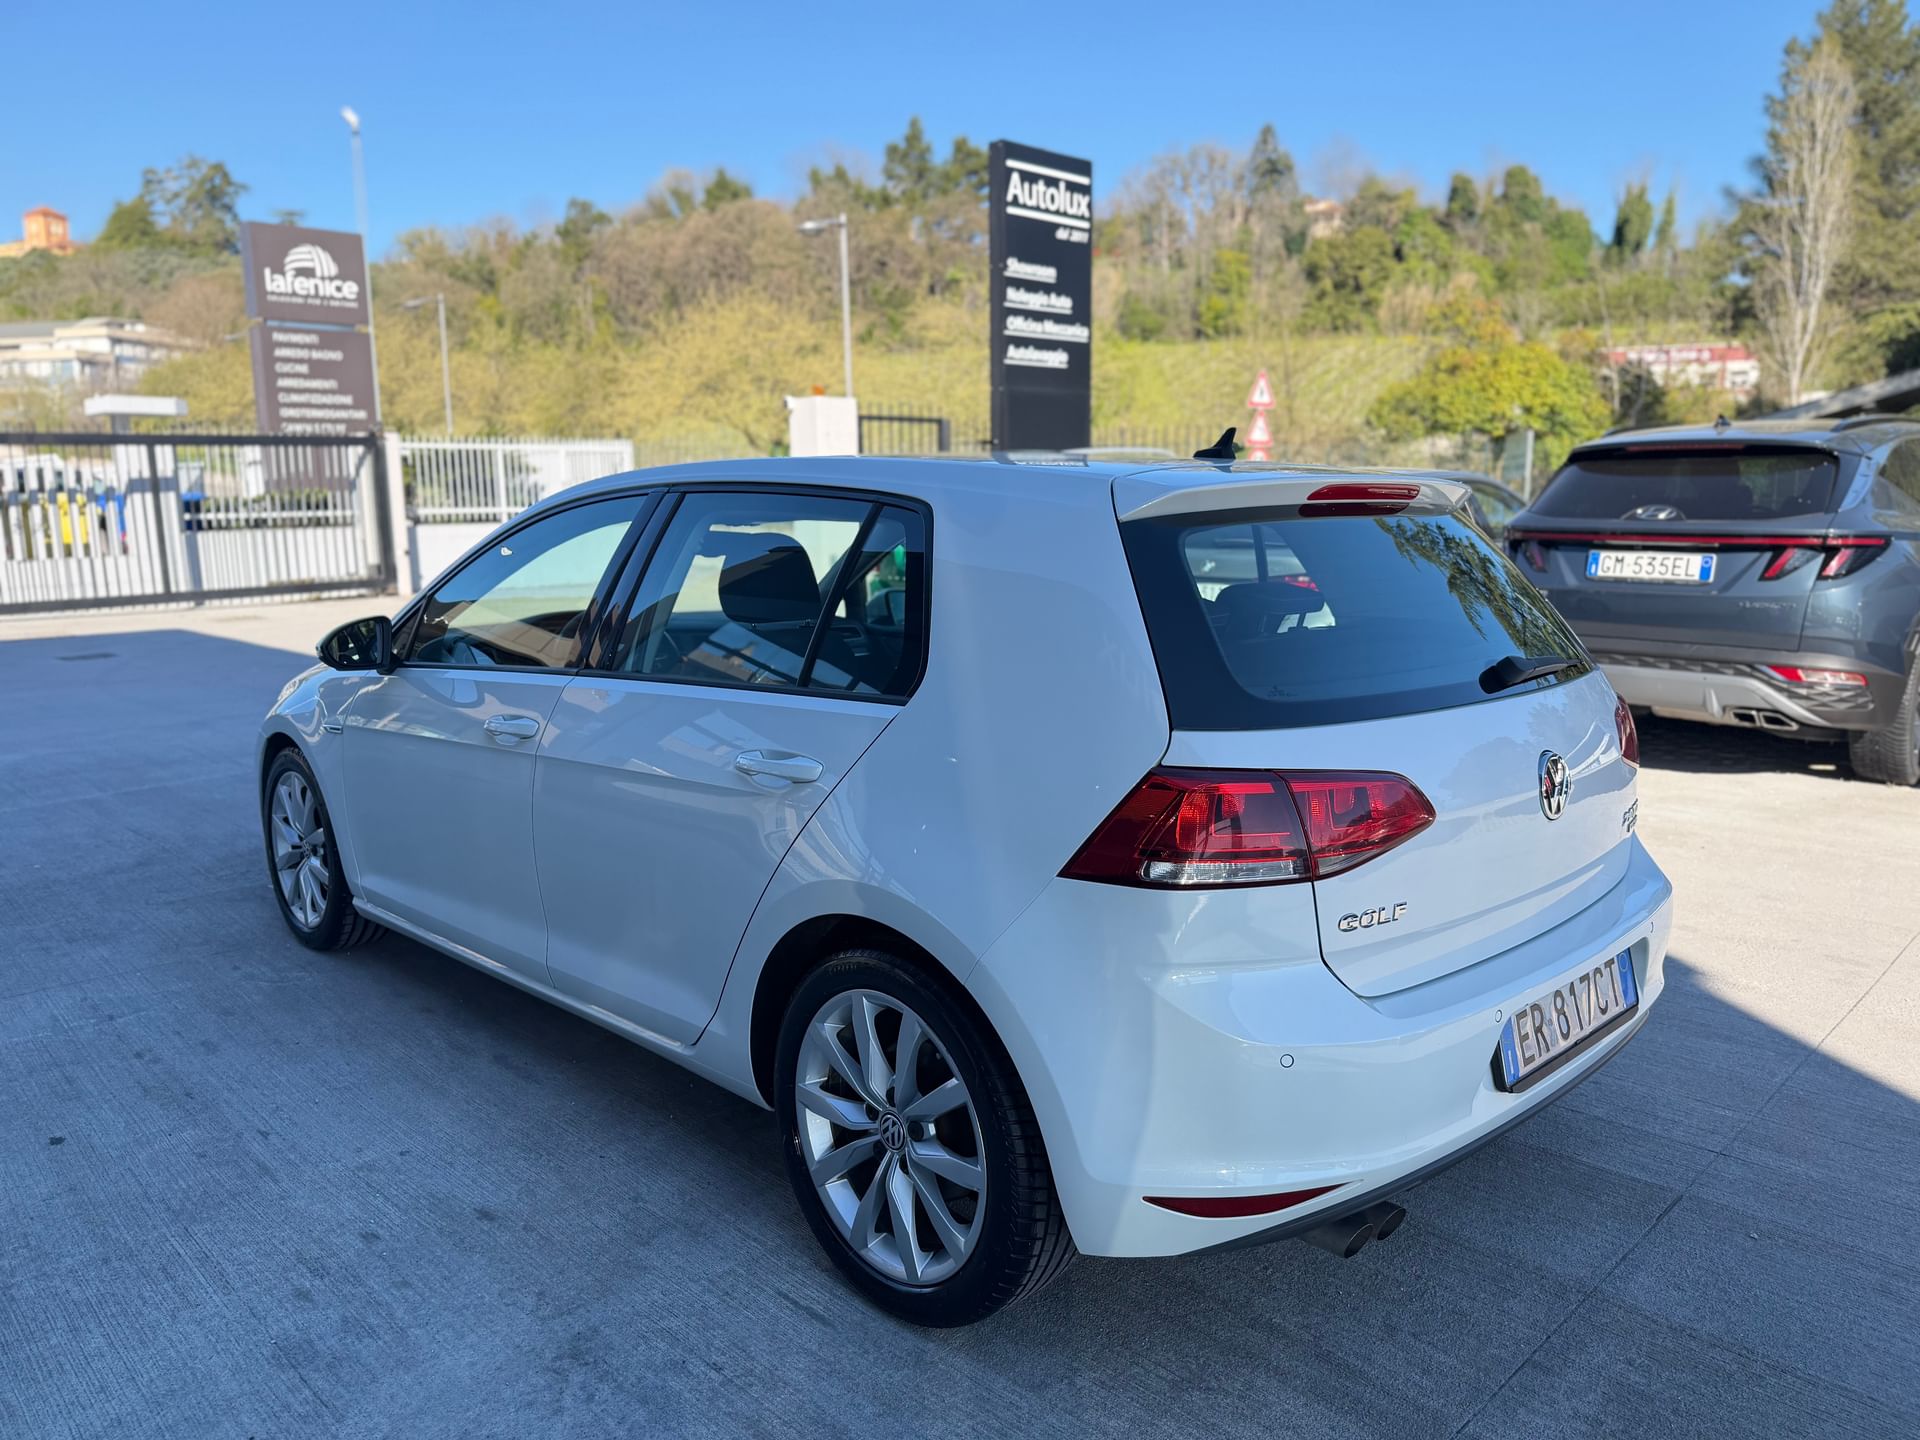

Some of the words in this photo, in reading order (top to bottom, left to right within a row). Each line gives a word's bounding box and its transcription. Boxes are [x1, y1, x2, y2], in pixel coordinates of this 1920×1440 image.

[1006, 170, 1090, 218] Autolux
[264, 267, 359, 300] lafenice
[1006, 287, 1048, 307] Noleggio
[1049, 293, 1073, 309] Auto
[1006, 315, 1043, 332] Officina
[1600, 555, 1625, 574] GM
[1632, 556, 1696, 577] 535EL
[1338, 901, 1408, 933] GOLF
[1515, 1003, 1550, 1067] ER
[1553, 957, 1620, 1041] 817CT
